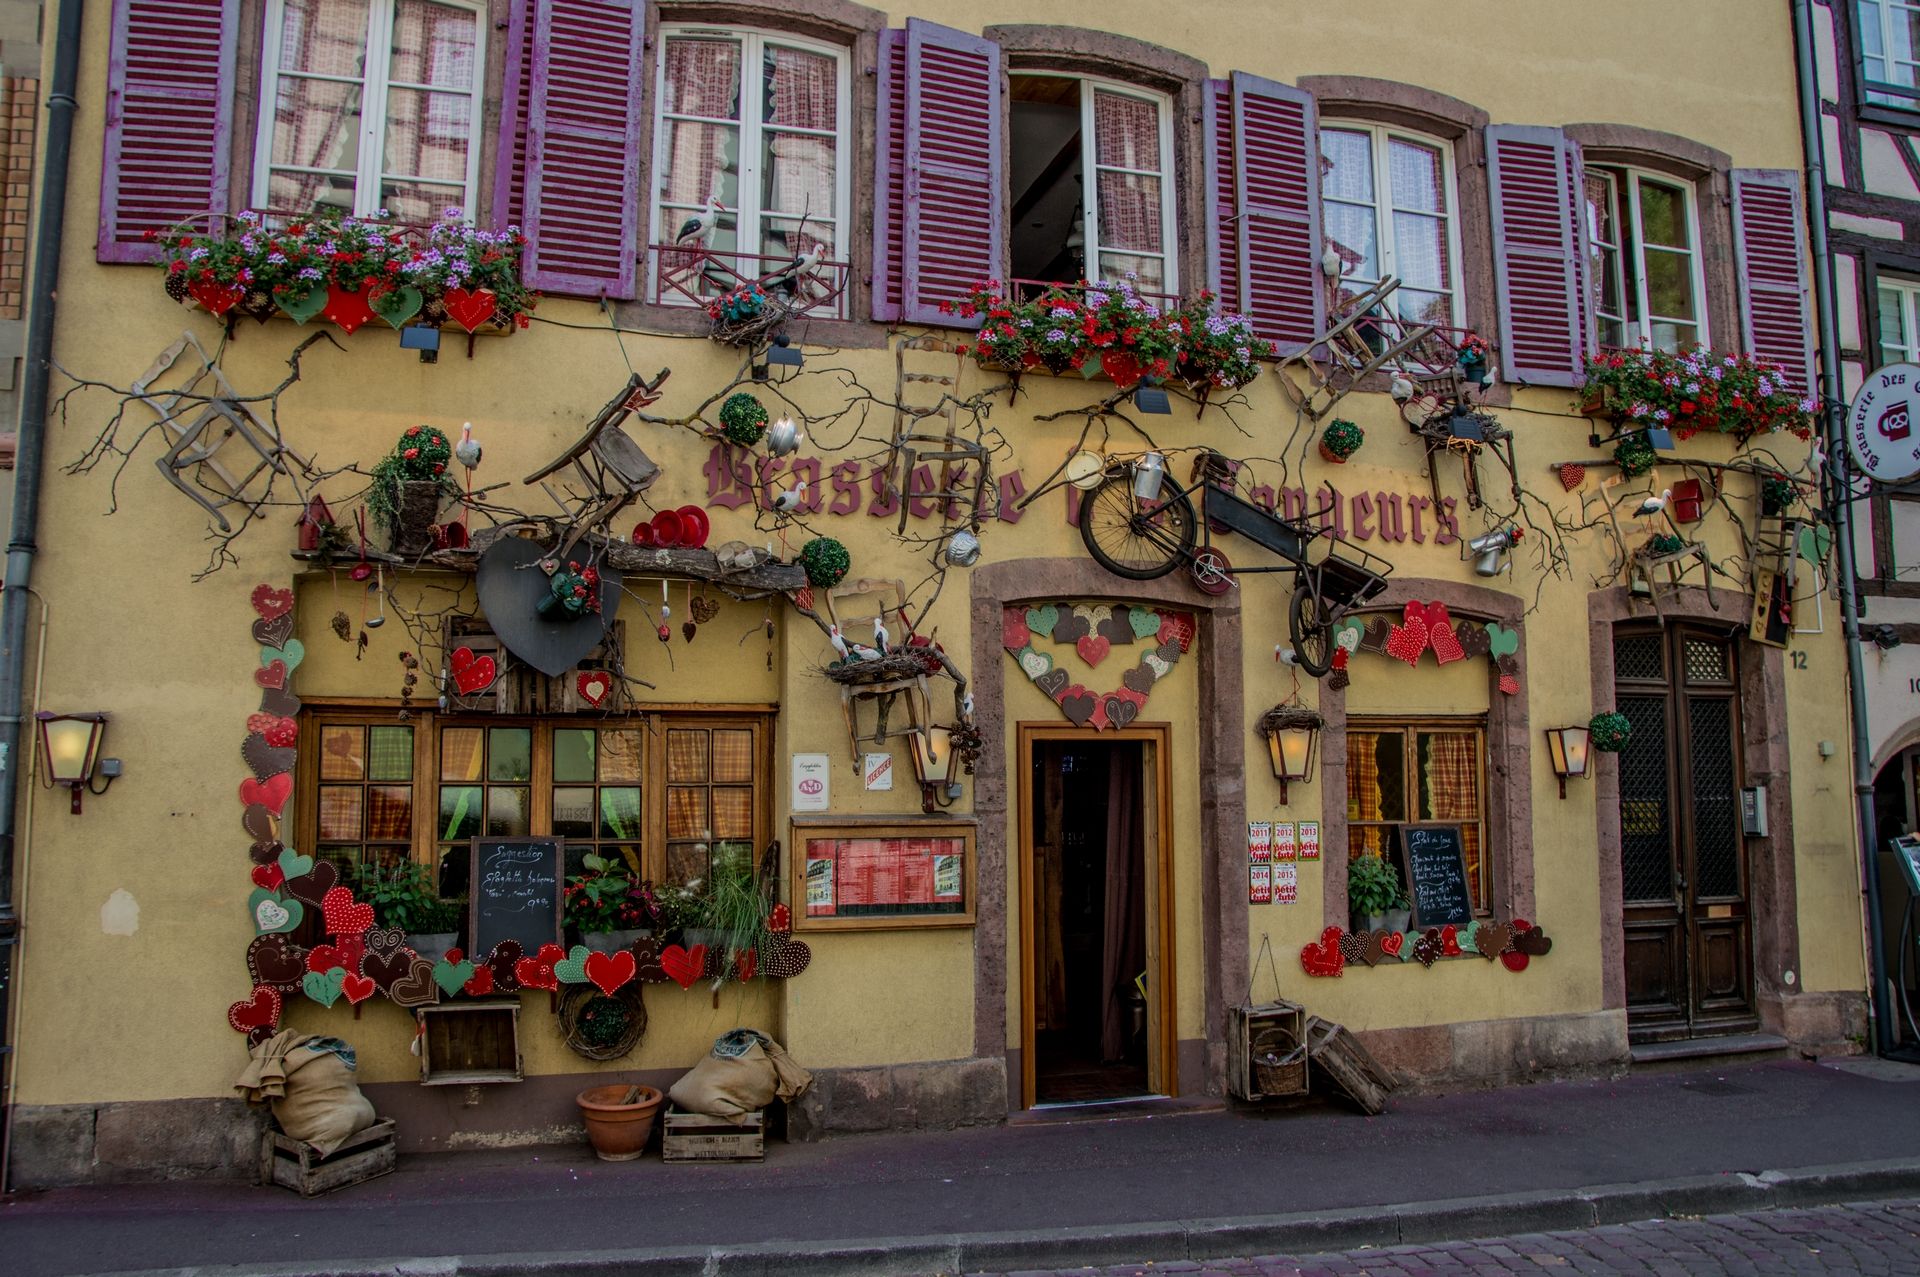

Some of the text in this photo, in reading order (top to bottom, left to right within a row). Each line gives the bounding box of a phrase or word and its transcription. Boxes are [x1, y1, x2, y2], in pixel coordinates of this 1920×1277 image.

[1855, 374, 1906, 472] Brasserie des
[1203, 459, 1460, 546] anneurs
[1789, 650, 1808, 670] 12
[867, 759, 892, 785] LICENCE
[1251, 829, 1268, 837] 2011
[1276, 828, 1293, 837] 2012
[1301, 828, 1317, 836] 2013
[1252, 871, 1269, 879] 2014
[1277, 870, 1294, 879] 2015
